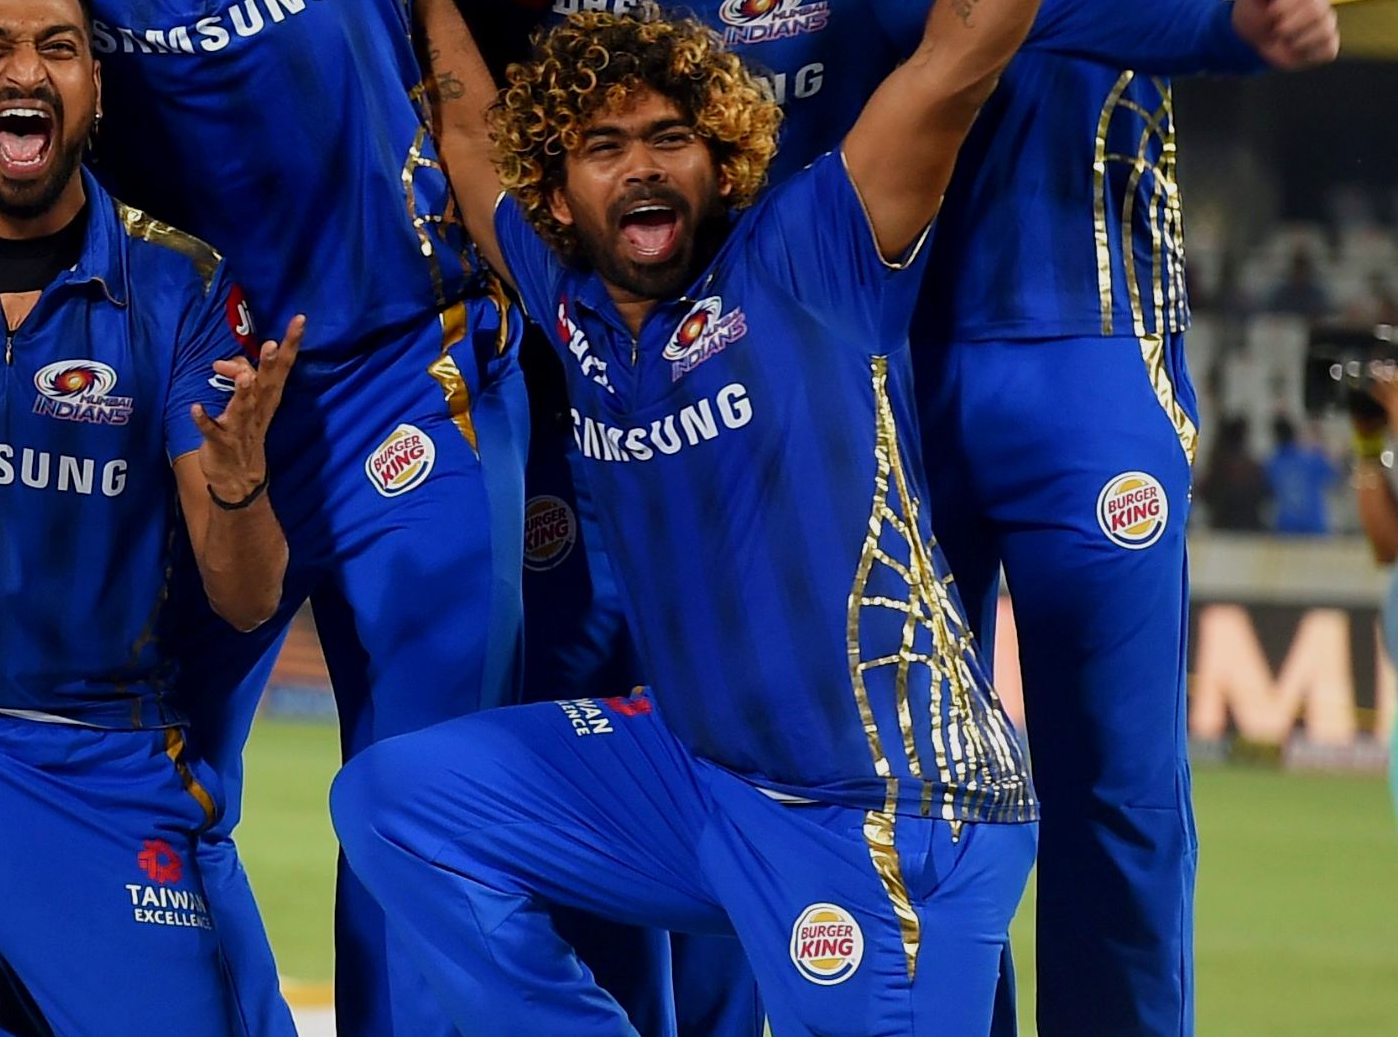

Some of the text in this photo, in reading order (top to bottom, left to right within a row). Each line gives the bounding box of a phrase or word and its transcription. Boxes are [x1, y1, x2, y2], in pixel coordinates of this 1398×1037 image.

[722, 15, 830, 45] INDIANS
[32, 396, 132, 425] INDIANS
[80, 395, 132, 408] MUMBAI
[374, 434, 421, 472] BURGER
[380, 445, 425, 488] KING
[1108, 485, 1158, 513] BURGER
[525, 507, 567, 533] URGER
[1111, 500, 1161, 532] KING
[126, 883, 208, 914] TAIWAN
[134, 907, 212, 930] EXCELLENCE
[800, 924, 853, 941] BURGER
[800, 938, 854, 960] KING
